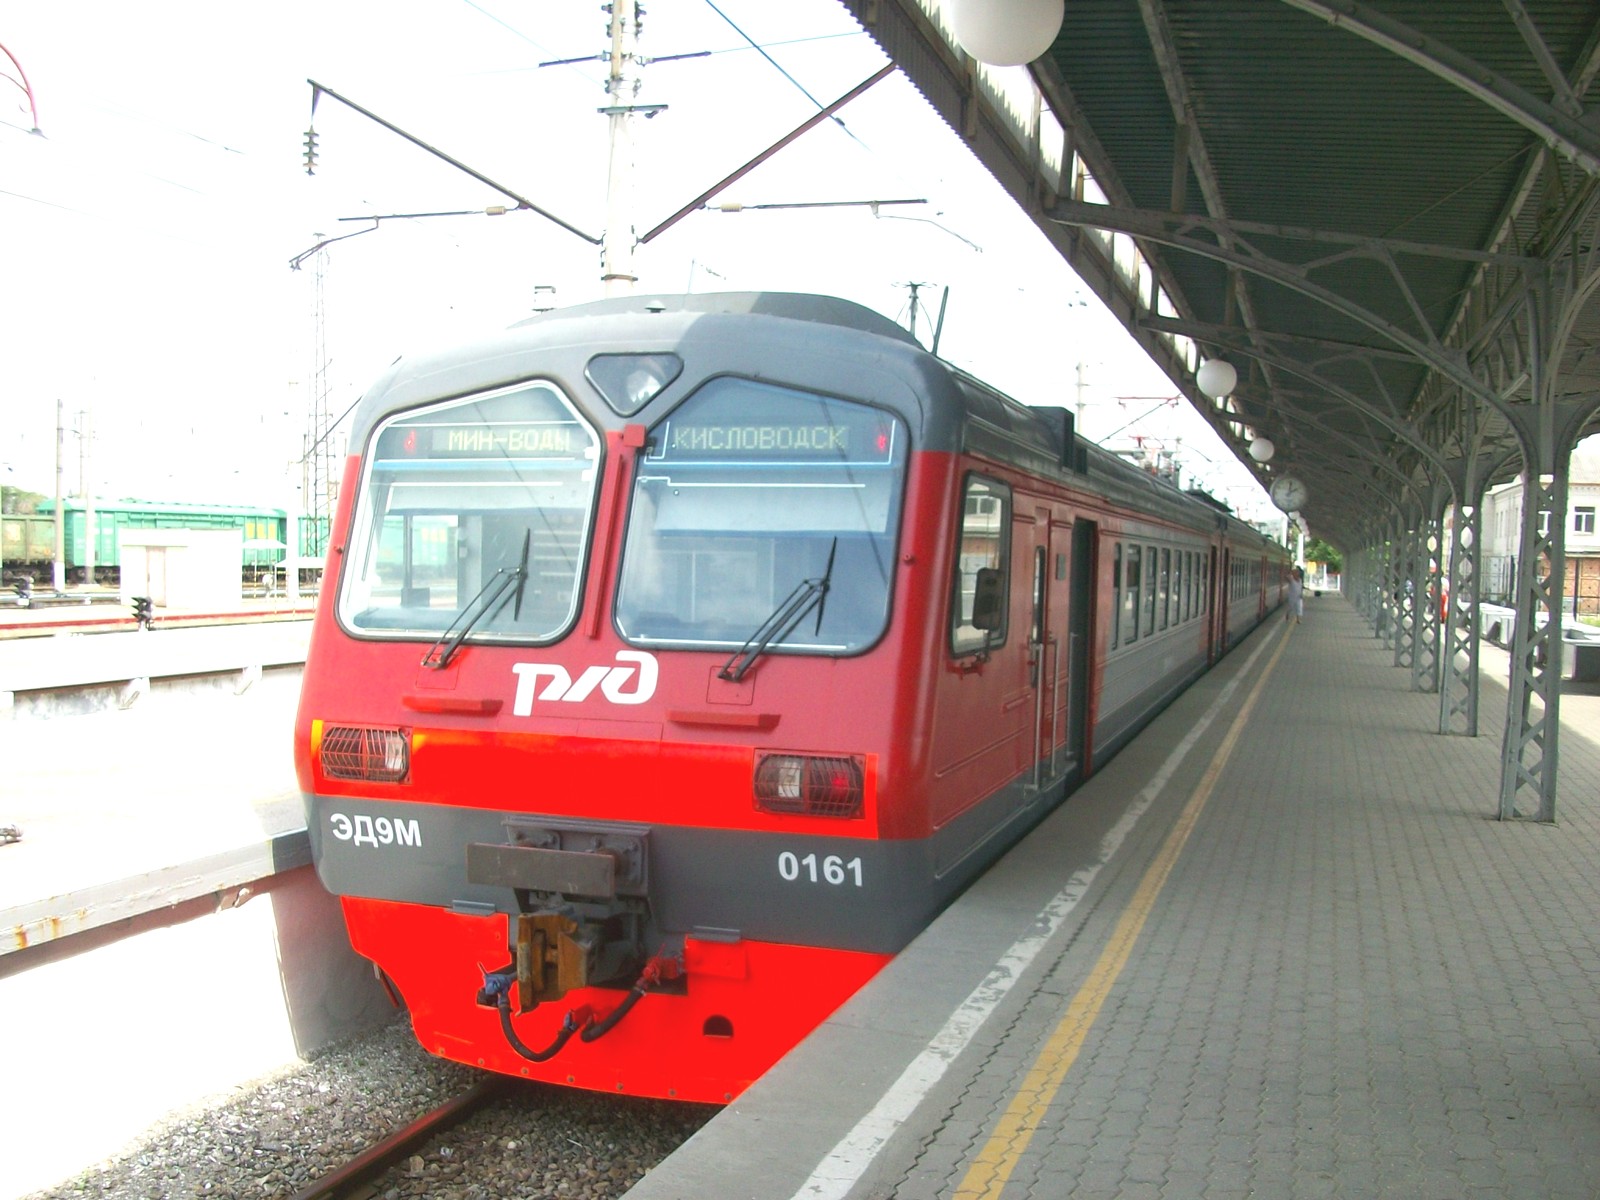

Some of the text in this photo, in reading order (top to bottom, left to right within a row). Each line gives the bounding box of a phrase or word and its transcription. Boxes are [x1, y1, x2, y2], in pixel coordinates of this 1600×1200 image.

[449, 429, 570, 451] МИН-ВОДЫ
[673, 426, 847, 450] КИСЛОВОДСК
[330, 813, 422, 848] ЭД9М
[778, 851, 863, 887] 0161
